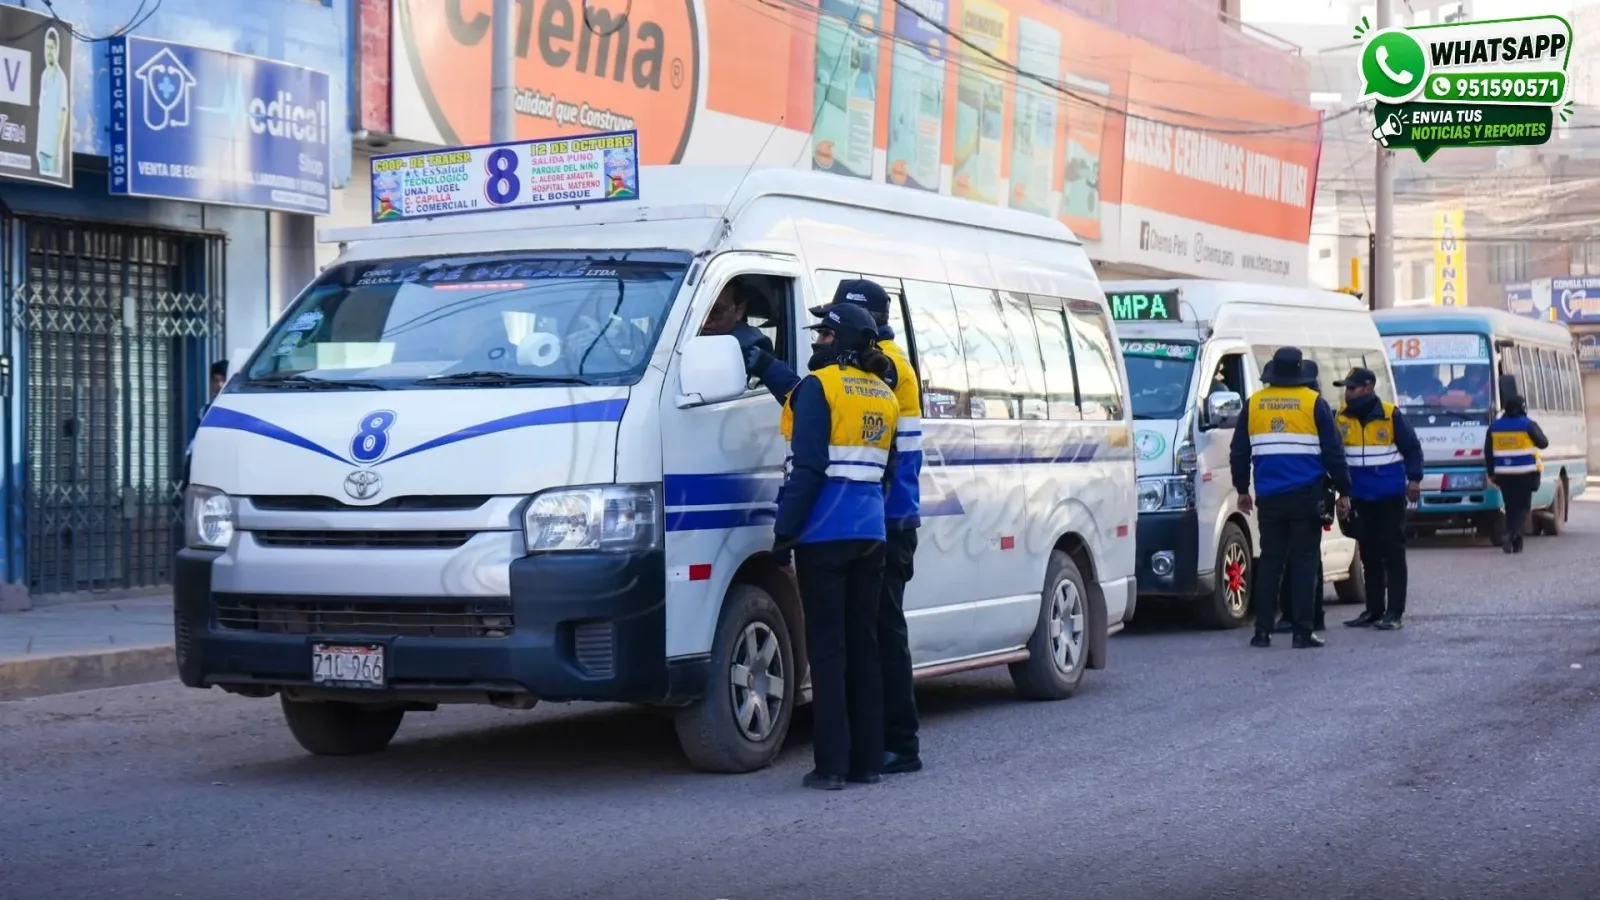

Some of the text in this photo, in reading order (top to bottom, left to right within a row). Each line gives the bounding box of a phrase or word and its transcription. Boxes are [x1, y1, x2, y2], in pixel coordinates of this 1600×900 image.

[514, 88, 555, 119] alidad
[556, 101, 579, 126] que
[530, 135, 633, 156] 12 DE OCTUBRE
[1125, 111, 1173, 172] CASAS
[113, 144, 125, 186] SHOP
[409, 156, 425, 169] DE
[532, 152, 593, 166] SALIDA PUNO
[137, 161, 169, 176] VENTA
[169, 163, 183, 178] DE
[532, 166, 561, 175] PARQUE
[563, 165, 578, 173] DEL
[484, 148, 520, 207] 8
[531, 171, 594, 184] C. ALEGRE AMAUTA
[404, 186, 428, 196] UNAJ
[436, 183, 460, 193] UGEL
[532, 180, 600, 193] HOSPITAL MATERNO
[404, 193, 452, 205] C. CAPILLA
[532, 190, 591, 202] EL BOSQUE
[404, 199, 477, 214] C. COMERCIAL II
[1391, 338, 1421, 359] 18
[844, 385, 855, 395] DE
[349, 408, 398, 464] 8
